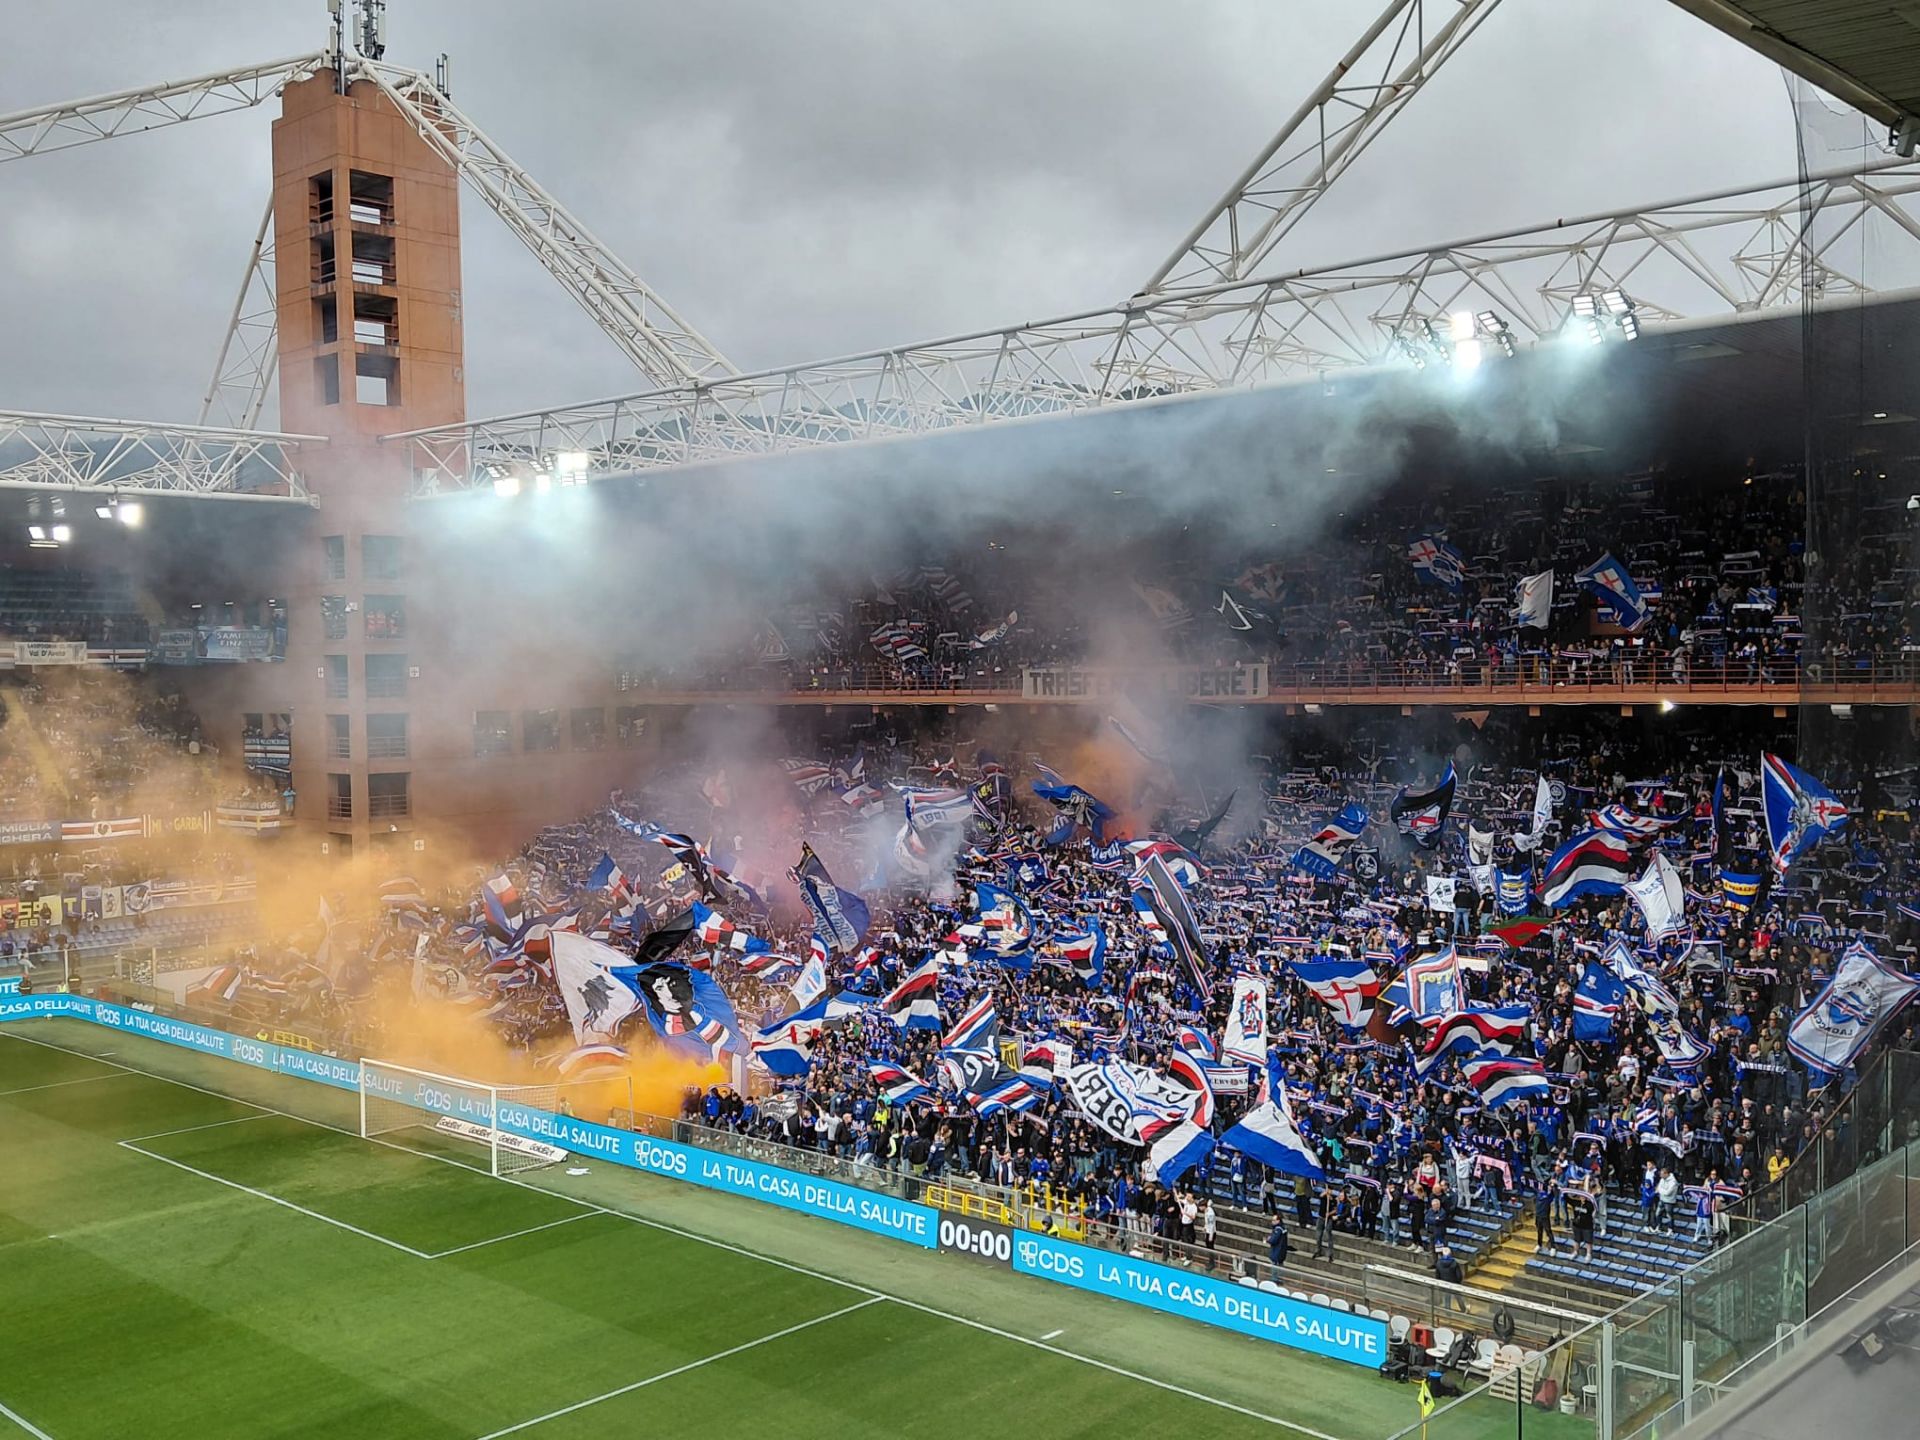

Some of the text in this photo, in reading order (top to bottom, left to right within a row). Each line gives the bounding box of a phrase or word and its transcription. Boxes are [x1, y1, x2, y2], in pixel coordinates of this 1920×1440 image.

[0, 822, 52, 833] MIGLIA
[0, 1000, 91, 1015] CASA DELLA SALUTE
[103, 1008, 224, 1050] CDS LA TUA CASA DELLA SALUTE
[241, 1044, 264, 1063] CDS
[272, 1052, 285, 1066] LA
[287, 1055, 304, 1071] TUA
[306, 1060, 330, 1077] CASA
[365, 1073, 403, 1094] SALUTE
[424, 1088, 451, 1111] CDS
[459, 1097, 473, 1114] LA
[500, 1108, 529, 1129] CASA
[533, 1116, 569, 1140] DELLA
[571, 1127, 620, 1154] SALUTE
[650, 1148, 926, 1235] CDS LA TUA CASA DELLA SALUTE
[940, 1219, 1011, 1261] 00:00
[1038, 1249, 1378, 1354] CDS LA TUA CASA DELLA SALUTE
